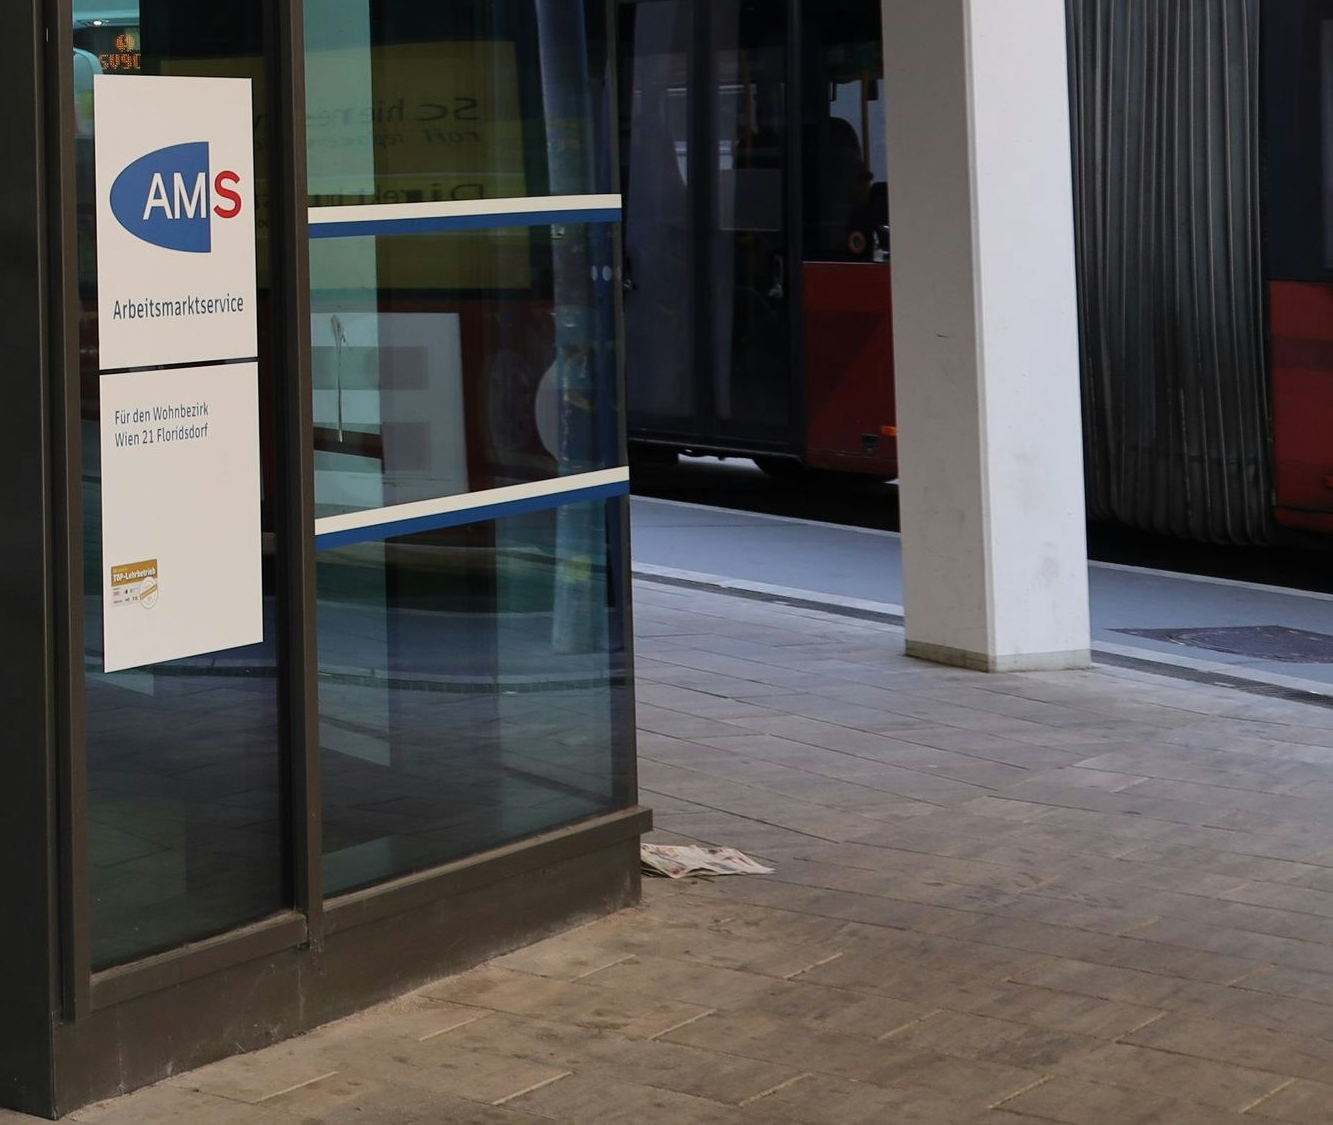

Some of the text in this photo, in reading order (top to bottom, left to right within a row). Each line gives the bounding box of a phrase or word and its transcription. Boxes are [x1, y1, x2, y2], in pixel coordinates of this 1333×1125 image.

[142, 170, 243, 221] AMS
[113, 293, 244, 320] Arbeitsmarktservice
[114, 402, 209, 426] Für den Wohnbezirk
[114, 422, 209, 448] Wien 21 Floridsdorf
